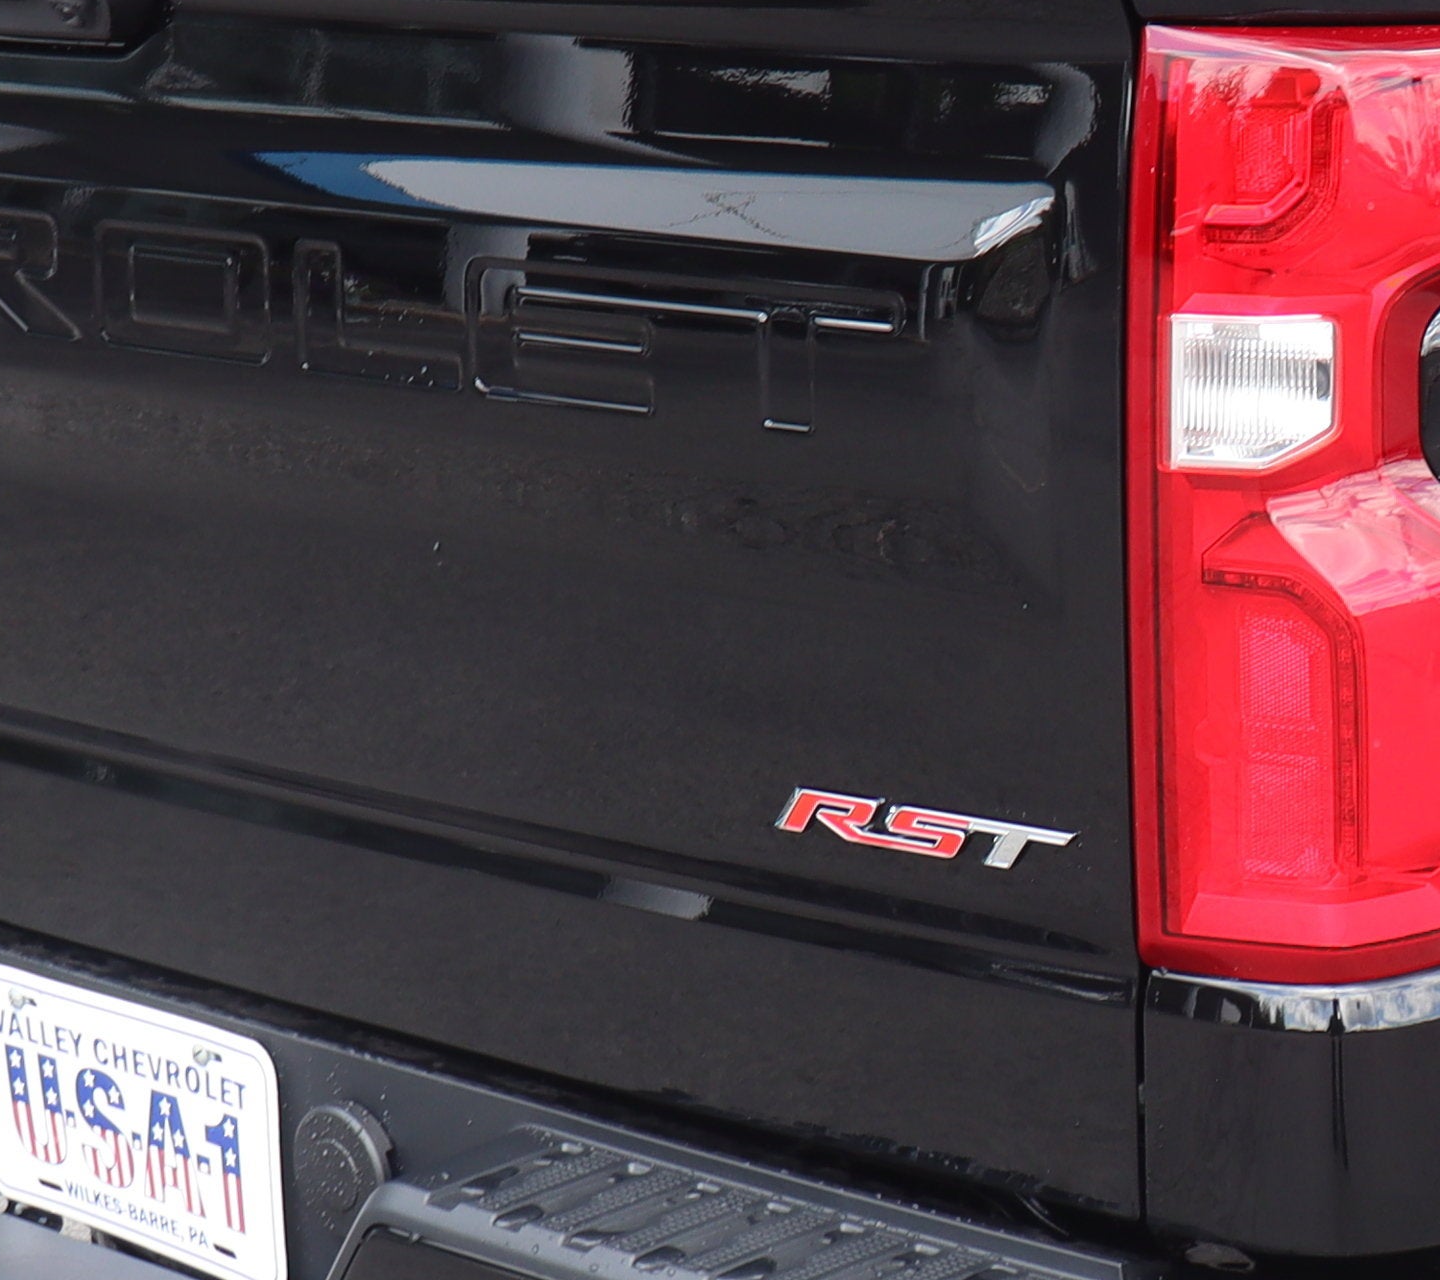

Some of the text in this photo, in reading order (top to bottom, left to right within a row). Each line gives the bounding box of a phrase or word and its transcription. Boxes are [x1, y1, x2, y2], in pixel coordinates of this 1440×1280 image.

[775, 785, 1080, 870] RST
[93, 1038, 247, 1110] CHEVROLET
[65, 1179, 209, 1248] WILKES-BARRE, PA
